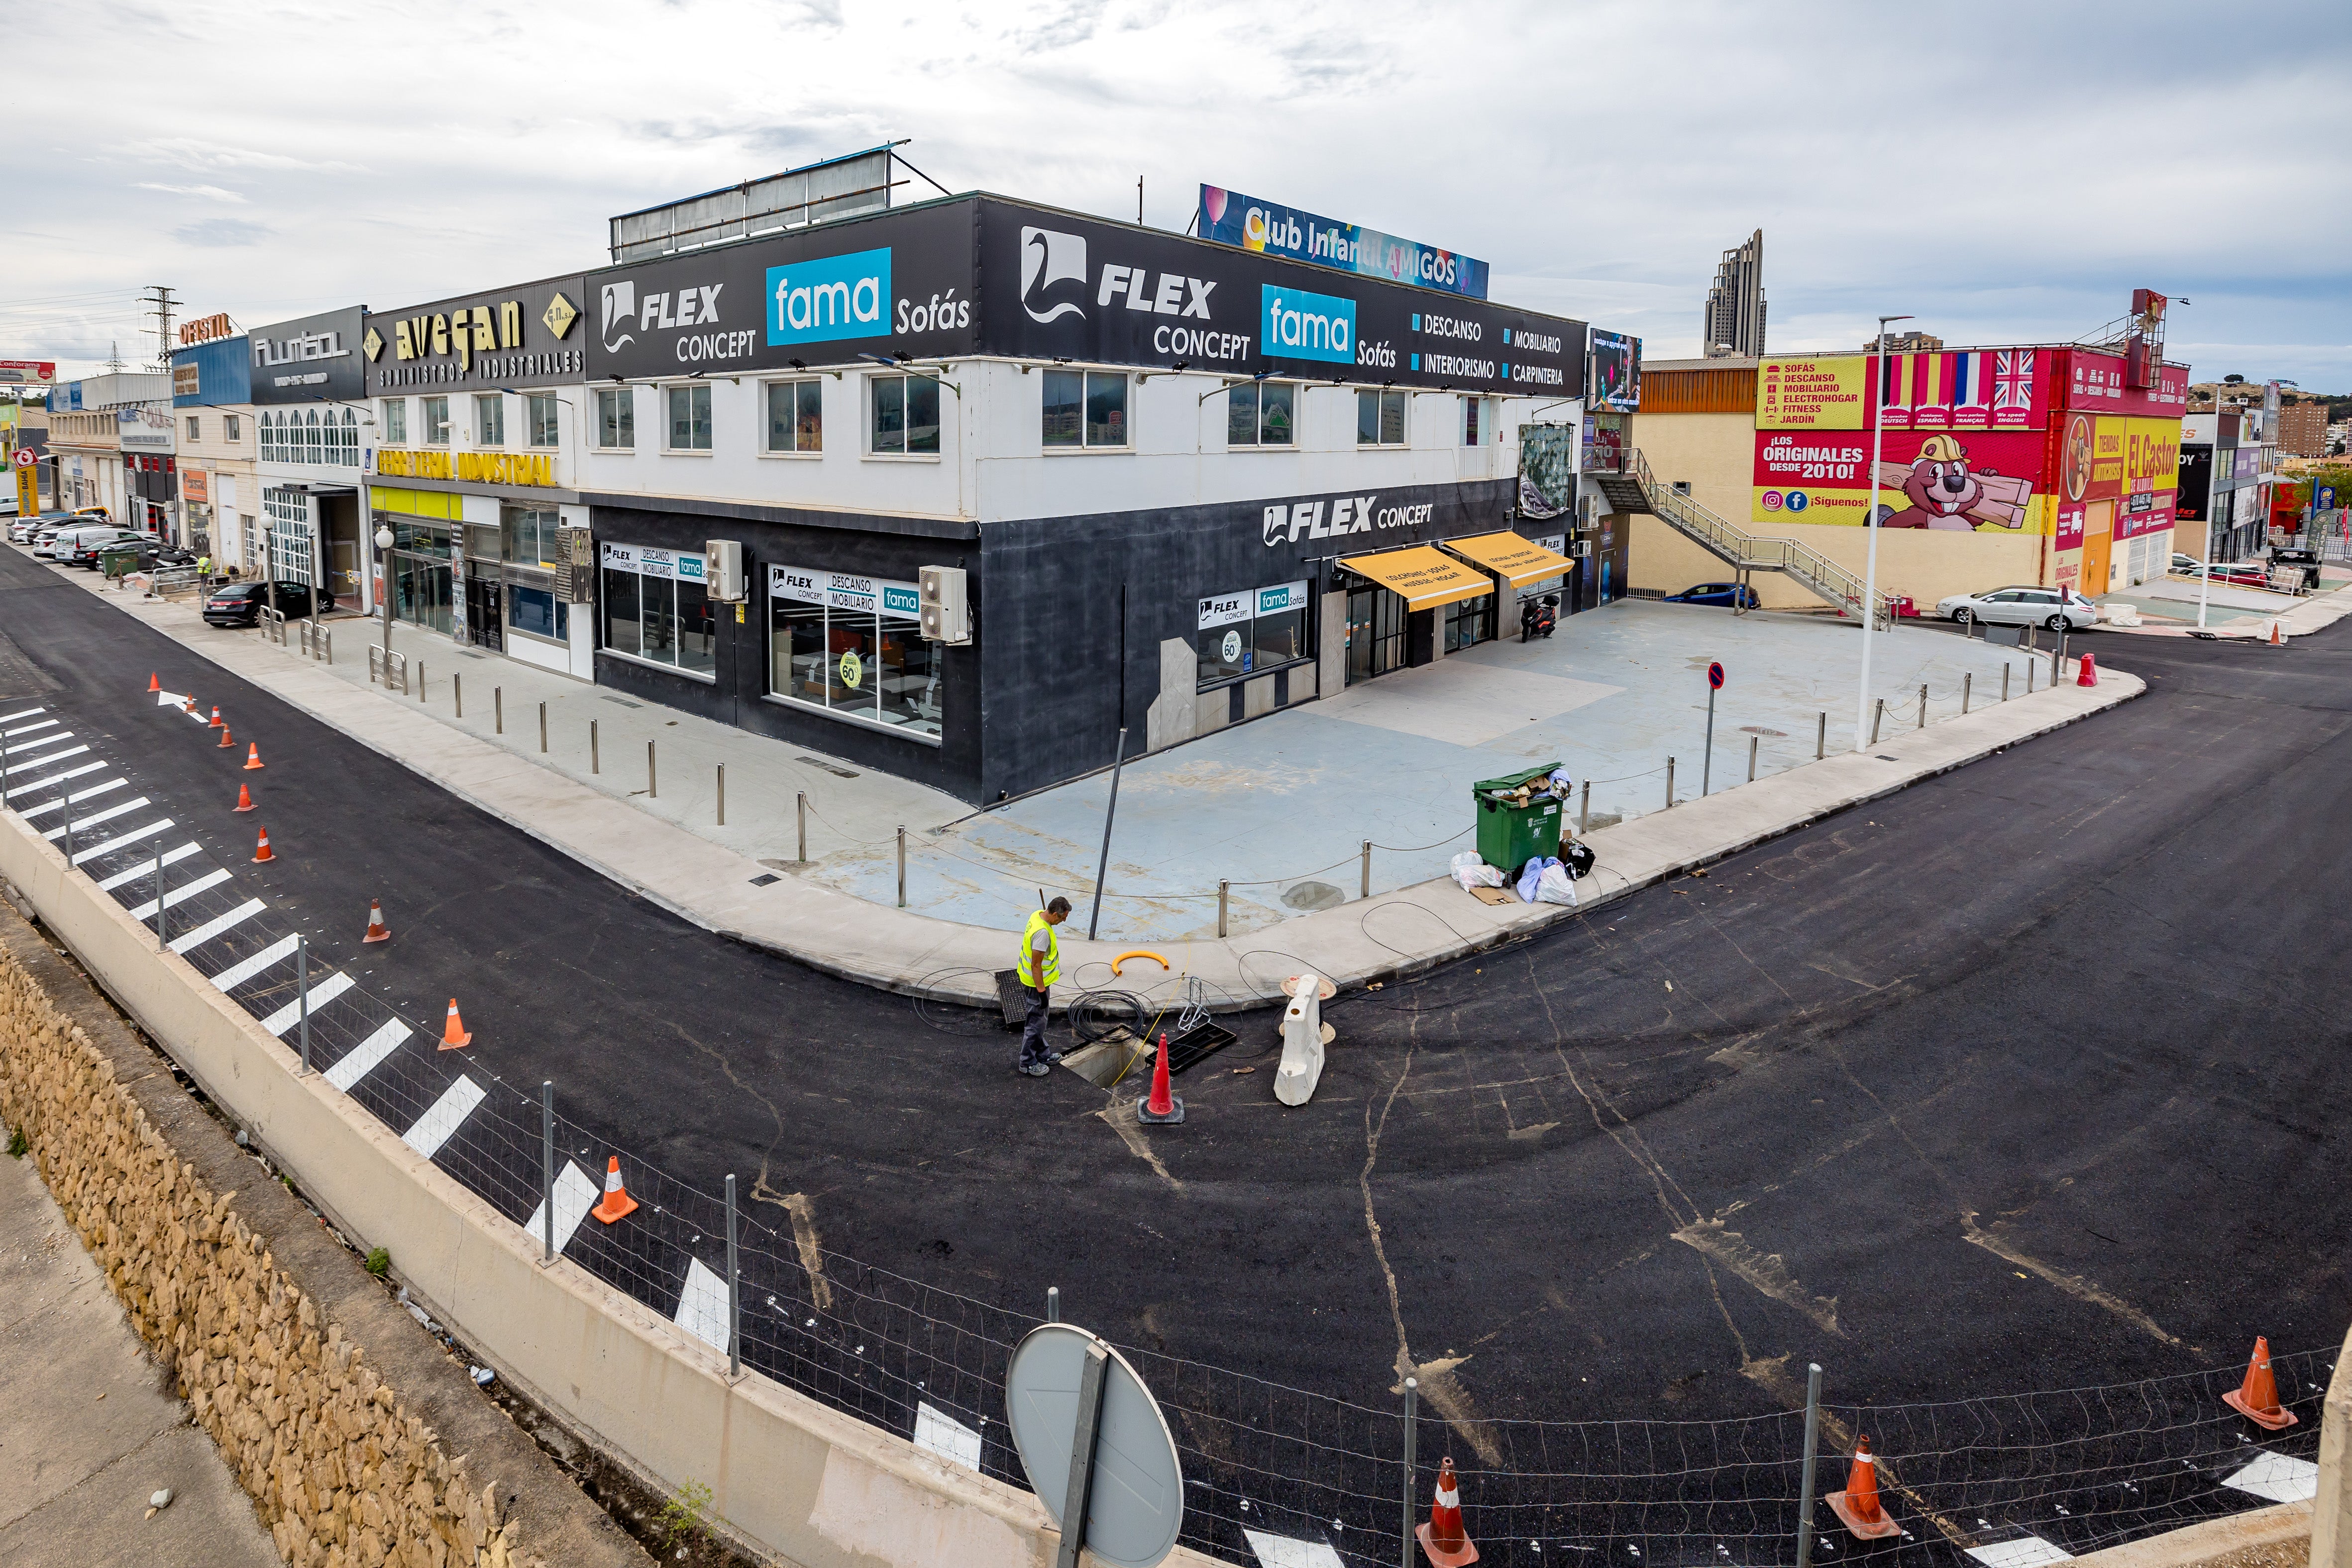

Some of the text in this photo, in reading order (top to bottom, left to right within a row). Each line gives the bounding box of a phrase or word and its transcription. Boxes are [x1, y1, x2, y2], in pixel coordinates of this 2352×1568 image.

[1245, 207, 1456, 285] Club Infantil AMIGOS
[1097, 264, 1217, 320] FLEX
[640, 283, 724, 331] FLEX
[775, 276, 970, 334] fama Sofás
[180, 313, 232, 344] OFISTIL
[1270, 298, 1396, 368] fama Sofás
[1425, 314, 1561, 354] DESCANSO MOBILIARIO
[676, 329, 756, 362] CONCEPT
[1154, 325, 1251, 361] CONCEPT
[380, 350, 583, 387] SUMINISTROS INDUSTRIALES
[1425, 354, 1563, 385] INTERIORISMO CARPINTERIA
[1785, 363, 1815, 373] SOFÁS
[1784, 374, 1835, 383] DESCANSO
[1784, 383, 1840, 393] MOBILIARIO
[1784, 394, 1858, 403] ELECTROHOGAR
[1783, 405, 1821, 413] FITNESS
[1780, 414, 1815, 424] JARDÍN
[1770, 436, 1793, 447] ¡LOS
[1763, 447, 1863, 463] ORIGINALES
[2099, 434, 2177, 478] TIENDAS El Castor
[1769, 463, 1854, 479] DESDE 2010!
[2093, 462, 2122, 482] ANTICRISIS
[19, 470, 29, 490] BAHÍA
[1811, 496, 1868, 508] ¡Síguenos!
[1288, 496, 1433, 542] FLEX CONCEPT
[1547, 540, 1560, 549] FLEX
[613, 548, 669, 562] FLEX DESCANSO
[621, 561, 637, 570] CONCEPT
[643, 563, 671, 577] MOBILIARIO
[681, 560, 700, 574] fama
[1386, 564, 1450, 581] COLCHONES SOFAS
[2055, 564, 2078, 581] ORIGINALES
[787, 575, 871, 592] FLEX DESCANSO
[1401, 572, 1462, 588] MUEBLES HOGAR
[798, 590, 917, 611] CONCEPT MOBILIARIO fama
[1214, 593, 1305, 614] FLEX fama Sofás
[1225, 610, 1248, 620] CONCEPT
